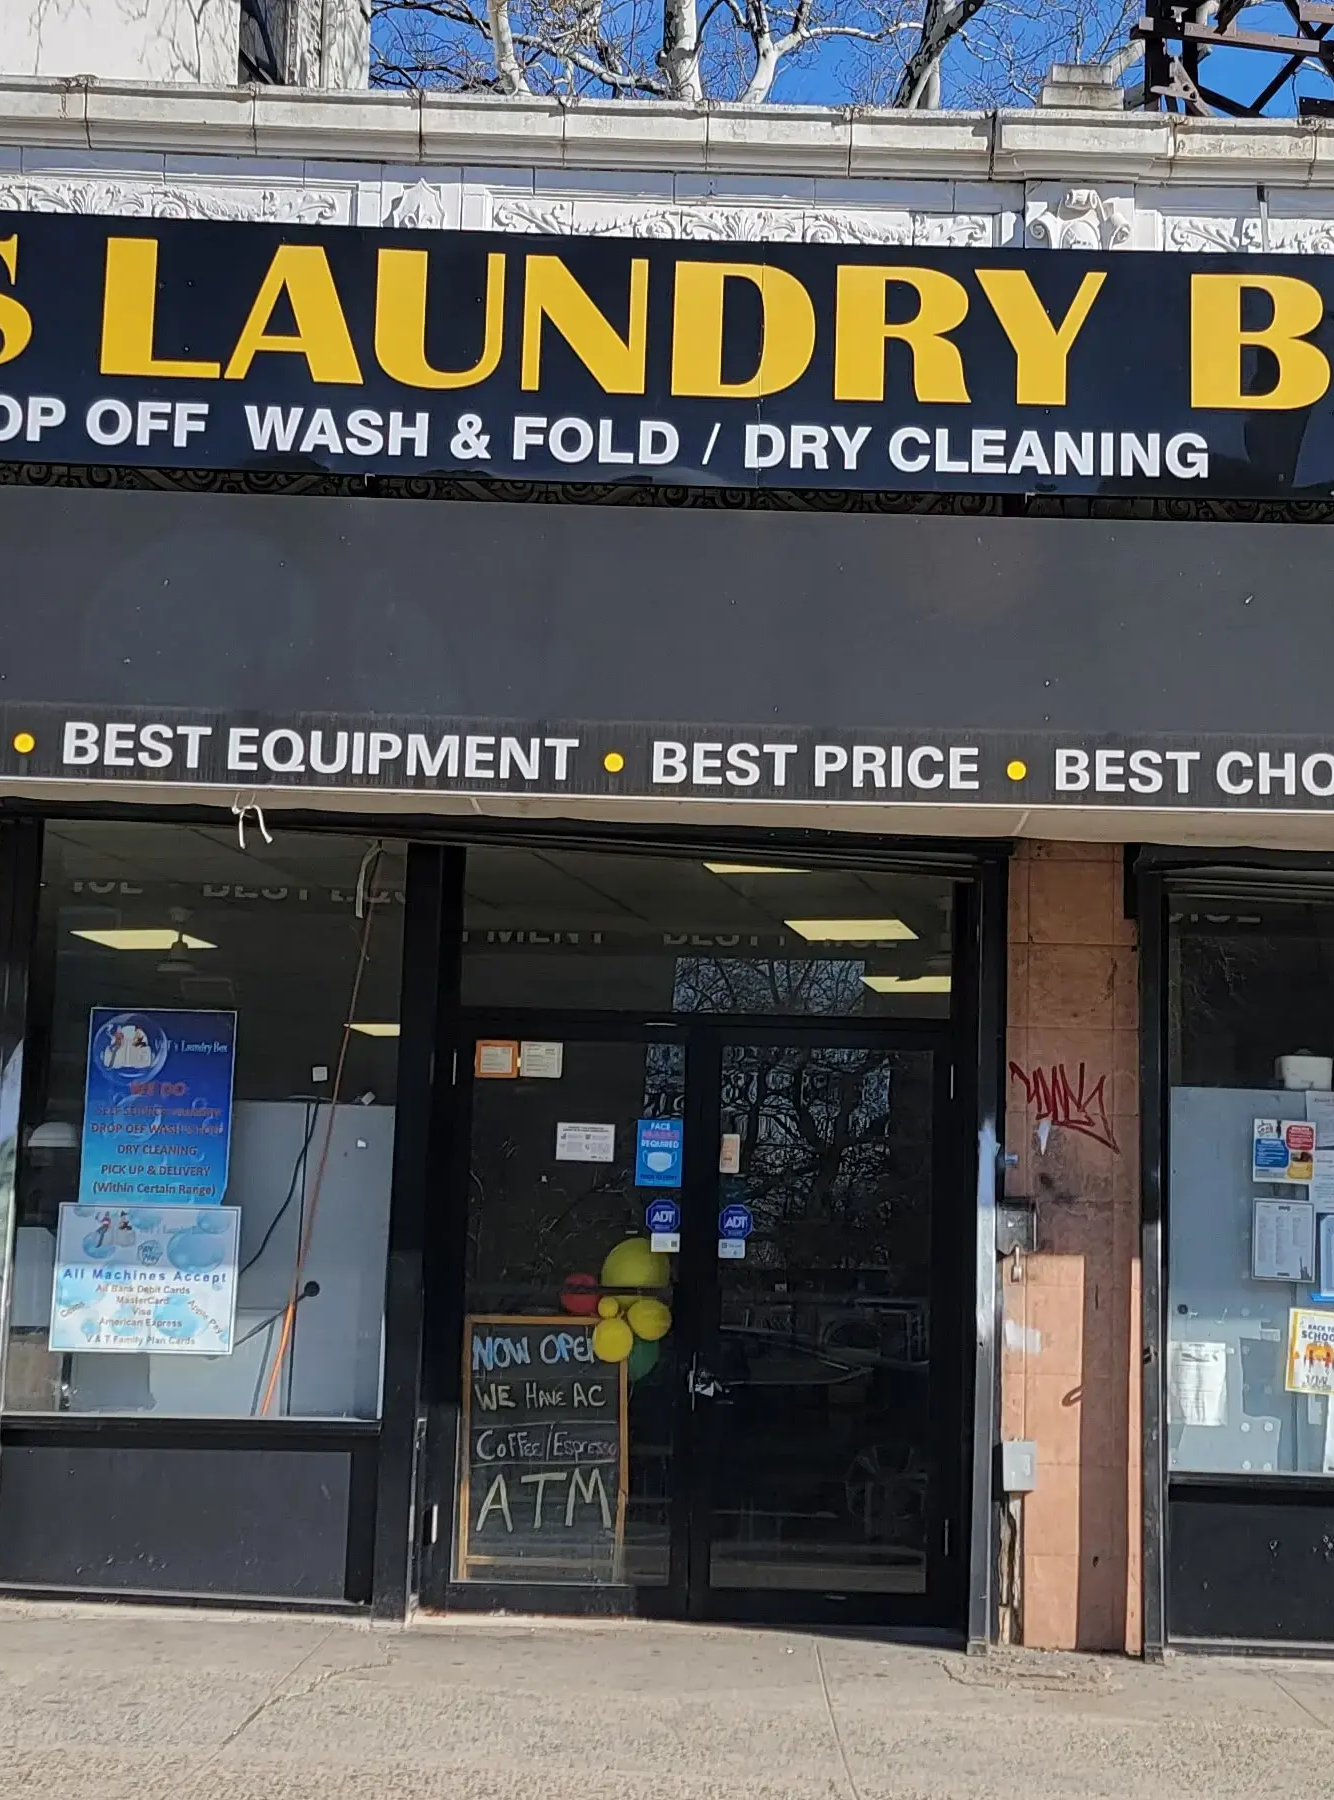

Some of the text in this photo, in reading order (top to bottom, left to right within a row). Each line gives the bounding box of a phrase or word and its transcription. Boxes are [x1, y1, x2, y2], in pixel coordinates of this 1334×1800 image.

[99, 236, 1109, 408] LAUNDRY
[84, 397, 208, 449] OFF
[243, 406, 429, 459] WASH
[449, 413, 491, 461] &
[512, 417, 681, 467] FOLD
[701, 422, 722, 465] /
[744, 425, 873, 474] DRY
[888, 428, 1210, 480] CLEANING
[62, 721, 213, 769] BEST
[226, 727, 580, 781] EQUIPMENT
[651, 740, 799, 787] BEST
[813, 744, 980, 790] PRICE
[1054, 748, 1202, 794] BEST
[160, 1081, 188, 1097] DO
[91, 1122, 123, 1134] DROP
[126, 1123, 146, 1134] OFF
[149, 1123, 181, 1136] WASH
[117, 1144, 198, 1156] DRY CLEANING
[101, 1164, 211, 1177] PICK UP & DELIVERY
[93, 1181, 216, 1197] (Within Certain Range)
[651, 1210, 676, 1223] ADT
[724, 1215, 748, 1229] ADT
[63, 1268, 227, 1285] All Machines Accept
[111, 1284, 134, 1293] Bank
[137, 1285, 161, 1294] Debit
[164, 1285, 191, 1295] Cards
[133, 1308, 152, 1317] Visa
[99, 1317, 183, 1329] American Express
[1307, 1324, 1327, 1332] BACK
[113, 1336, 143, 1346] Family
[146, 1336, 167, 1345] Plan
[168, 1337, 196, 1346] Cards
[472, 1334, 531, 1371] NOW
[474, 1382, 516, 1411] WE
[572, 1381, 606, 1408] AC
[475, 1467, 612, 1532] ATM
